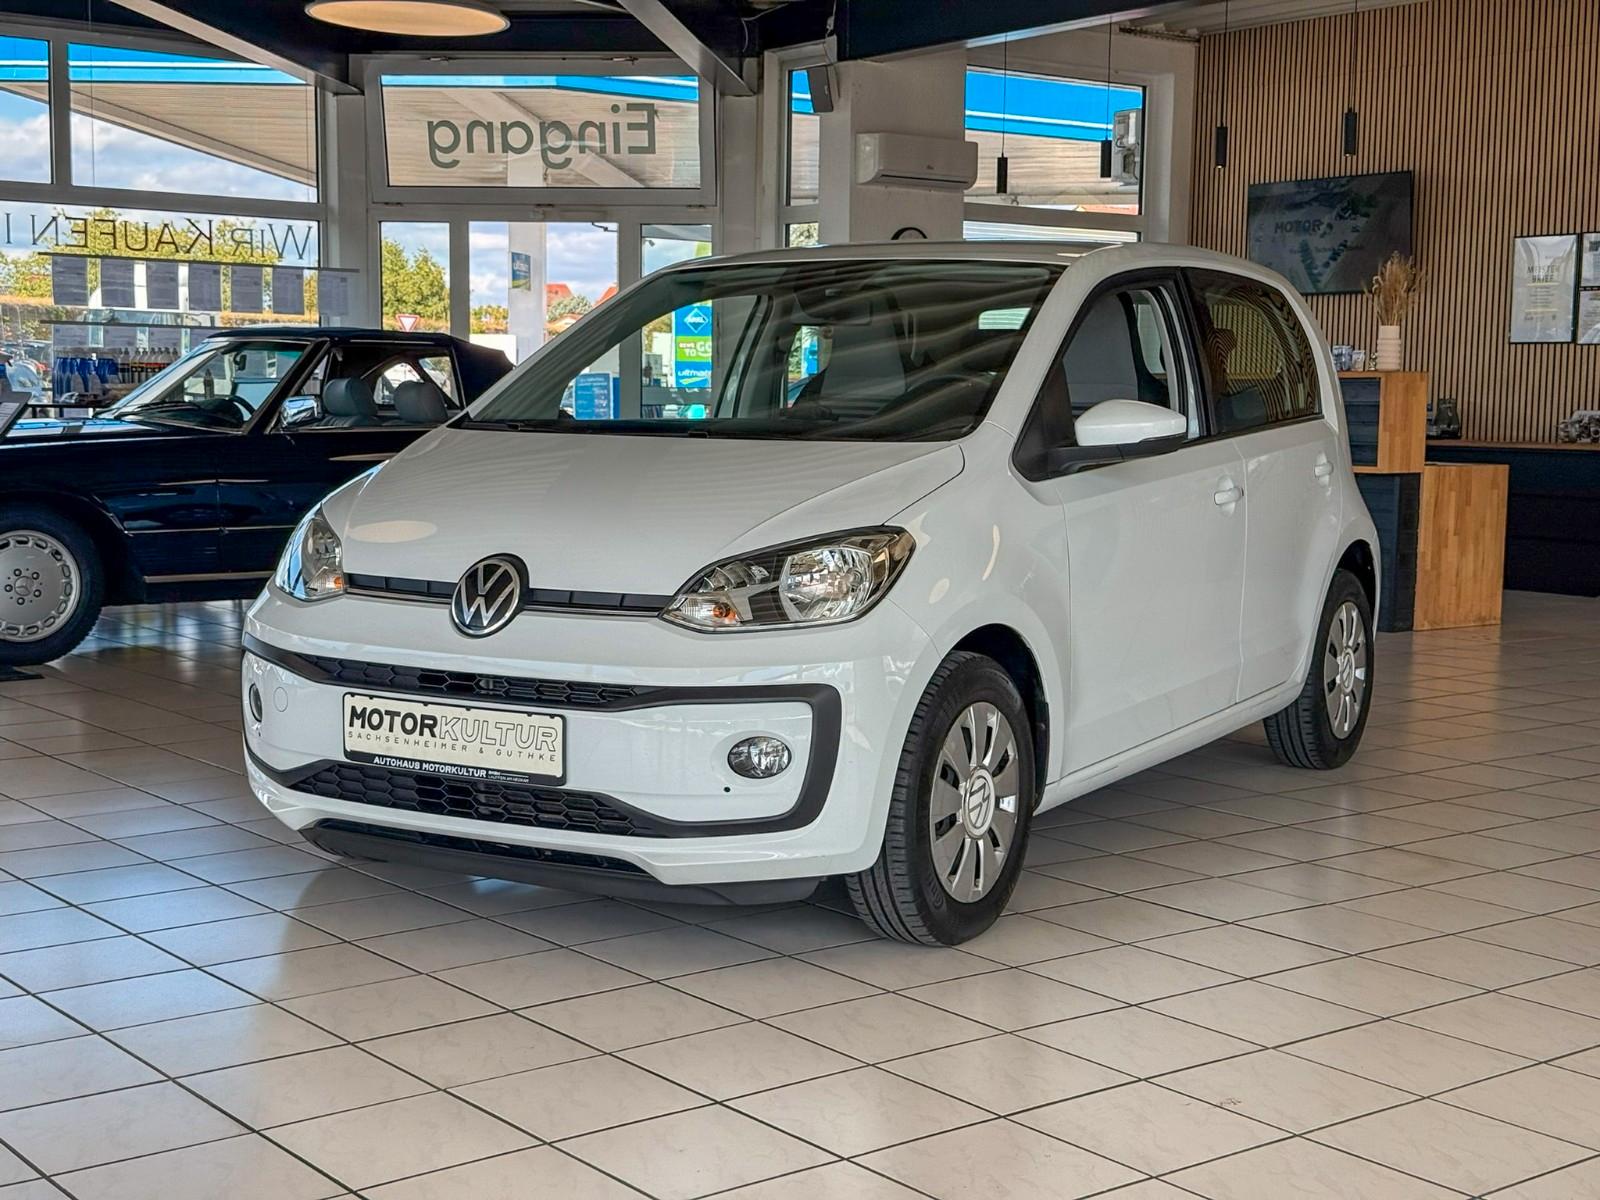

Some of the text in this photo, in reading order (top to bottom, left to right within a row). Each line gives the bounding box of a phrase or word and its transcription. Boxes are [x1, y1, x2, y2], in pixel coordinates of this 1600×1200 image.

[349, 705, 558, 752] MOTORKULTUR
[348, 731, 556, 761] SACHSENHEIMER & GUTHKE
[373, 756, 420, 770] AUTOHAUS
[422, 763, 487, 778] MOTORKULTUR
